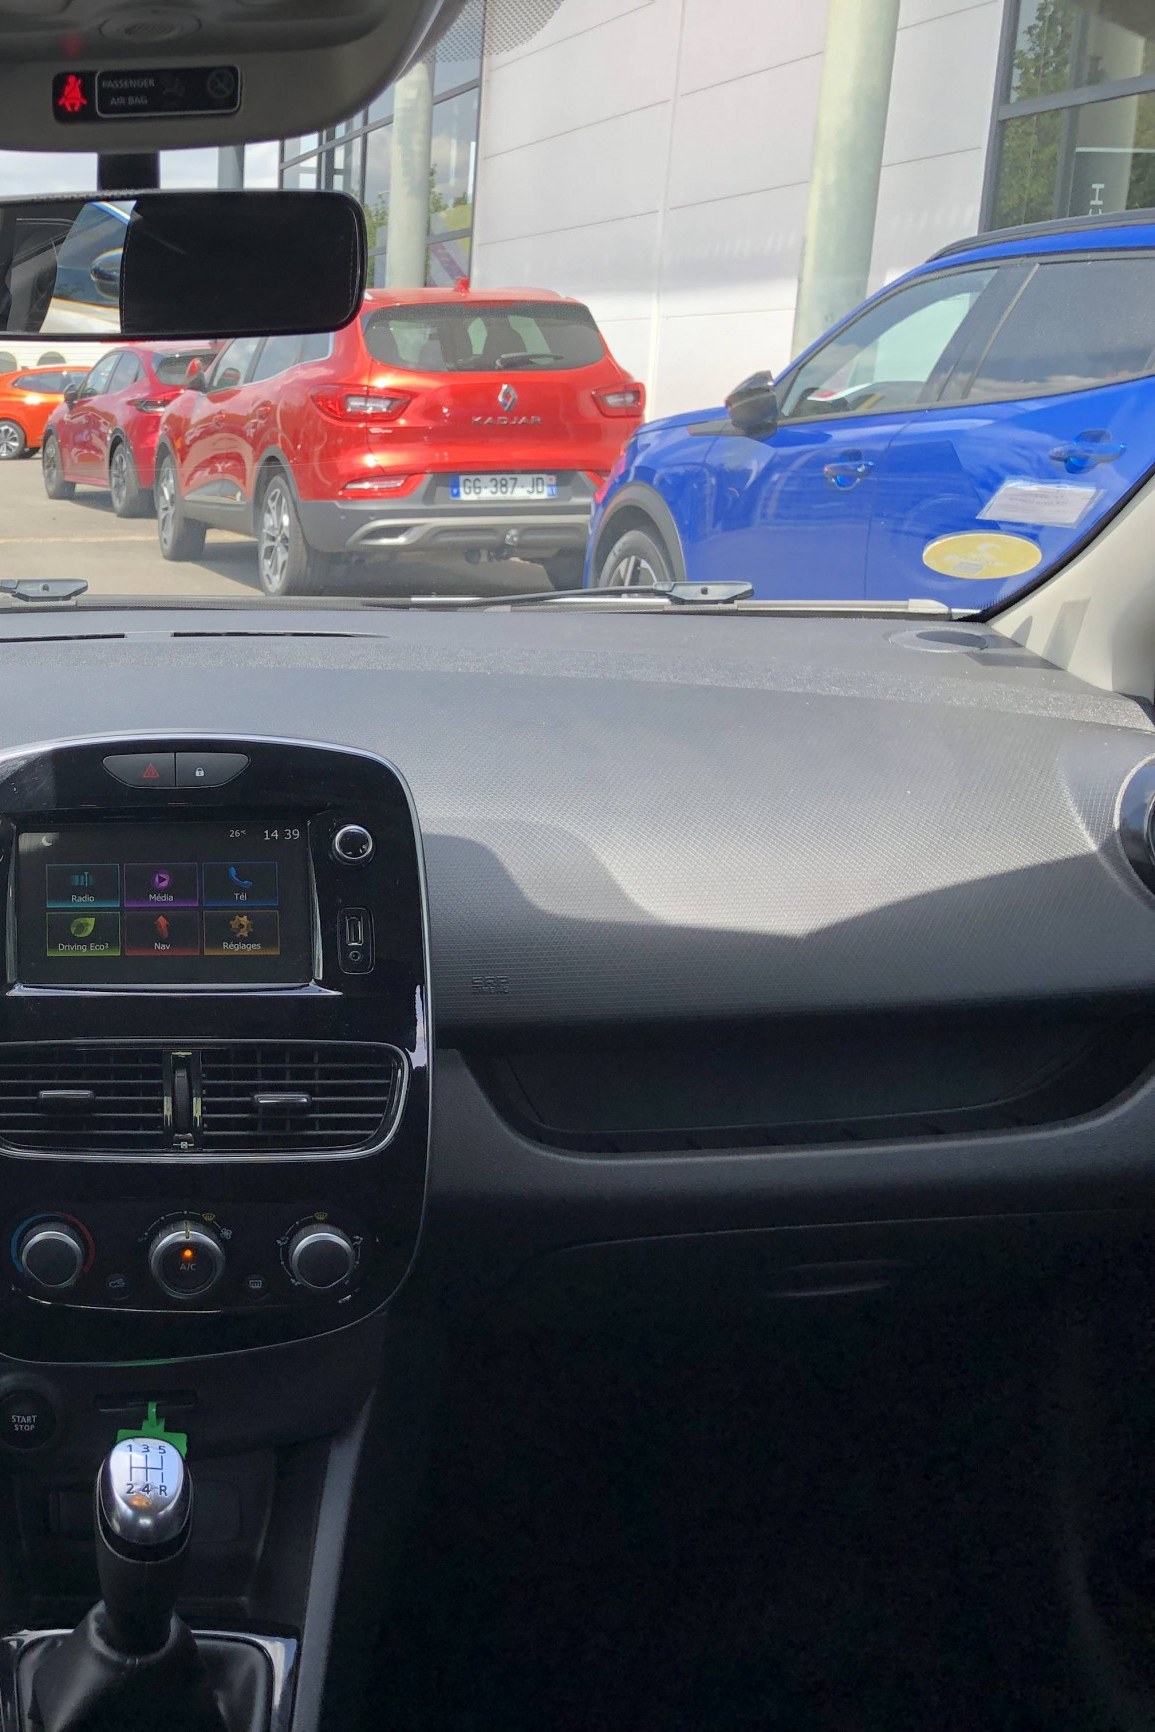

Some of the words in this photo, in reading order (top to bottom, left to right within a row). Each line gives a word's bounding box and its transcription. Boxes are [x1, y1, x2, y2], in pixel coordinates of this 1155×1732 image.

[102, 78, 155, 88] PASSENGER
[110, 96, 125, 105] AIR
[128, 95, 148, 105] BAG
[471, 416, 542, 425] KADJAR
[71, 894, 95, 902] Radio
[149, 893, 174, 902] Média
[234, 892, 247, 901] Tél
[58, 943, 87, 953] Driving
[154, 942, 171, 951] Nav
[222, 941, 261, 951] Réglages
[179, 1262, 197, 1271] A/C
[11, 1414, 37, 1424] START
[127, 1444, 133, 1453] 1
[142, 1444, 150, 1453] 3
[158, 1445, 166, 1454] 5
[126, 1483, 134, 1494] 2
[141, 1483, 151, 1494] 4
[159, 1485, 167, 1496] R
